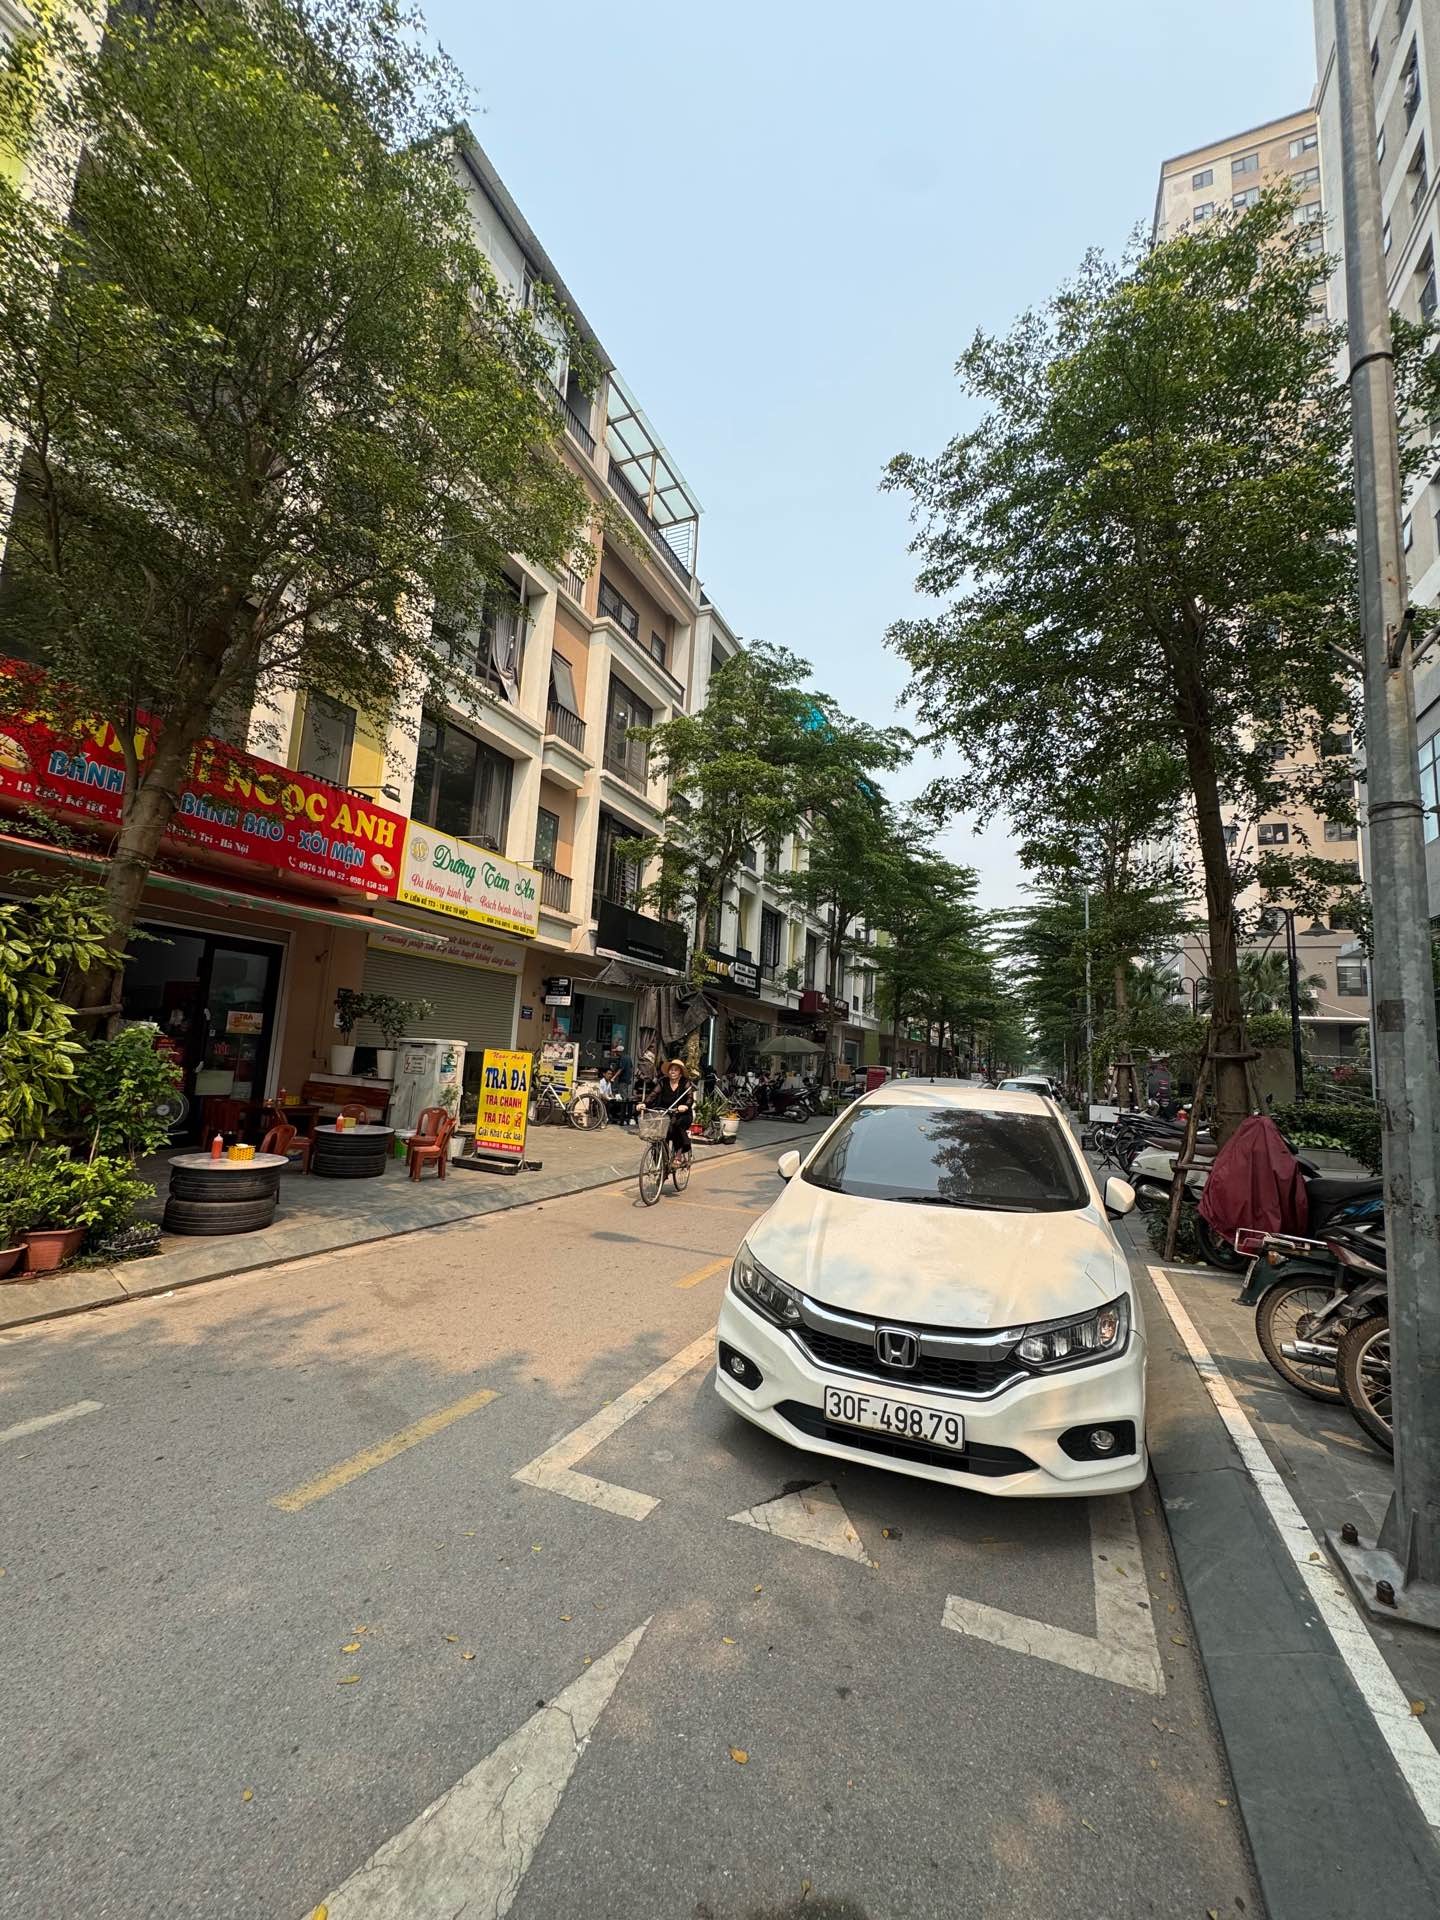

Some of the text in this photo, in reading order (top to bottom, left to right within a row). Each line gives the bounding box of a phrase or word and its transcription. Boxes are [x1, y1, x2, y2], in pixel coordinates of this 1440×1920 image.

[47, 749, 126, 794] BÁNH
[297, 829, 329, 857] XÔI
[330, 803, 397, 848] ANH
[481, 861, 510, 892] Tâm
[514, 878, 536, 901] An
[485, 1062, 508, 1090] TRÀ
[510, 1063, 527, 1092] ĐÁ
[500, 1095, 522, 1109] CHANH
[828, 1391, 960, 1445] 30F-498.79
